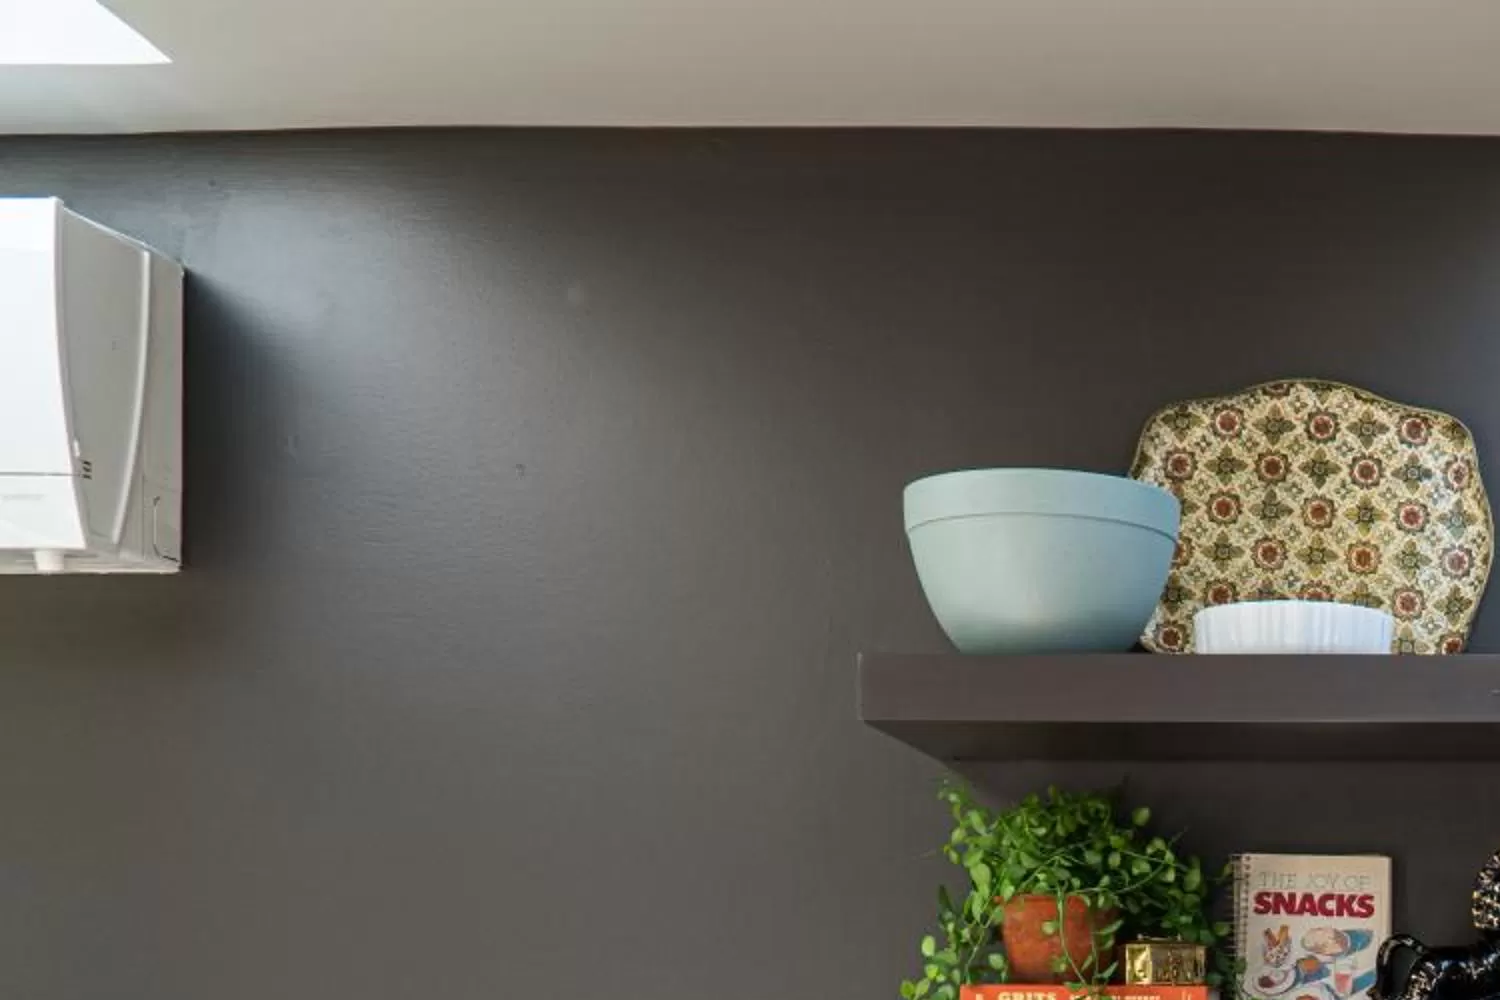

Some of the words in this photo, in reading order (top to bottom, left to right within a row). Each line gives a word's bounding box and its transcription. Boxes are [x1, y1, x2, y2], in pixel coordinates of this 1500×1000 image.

[1257, 872, 1297, 889] THE
[1306, 872, 1340, 889] JOY
[1343, 873, 1372, 890] OF
[1253, 891, 1375, 918] SNACKS
